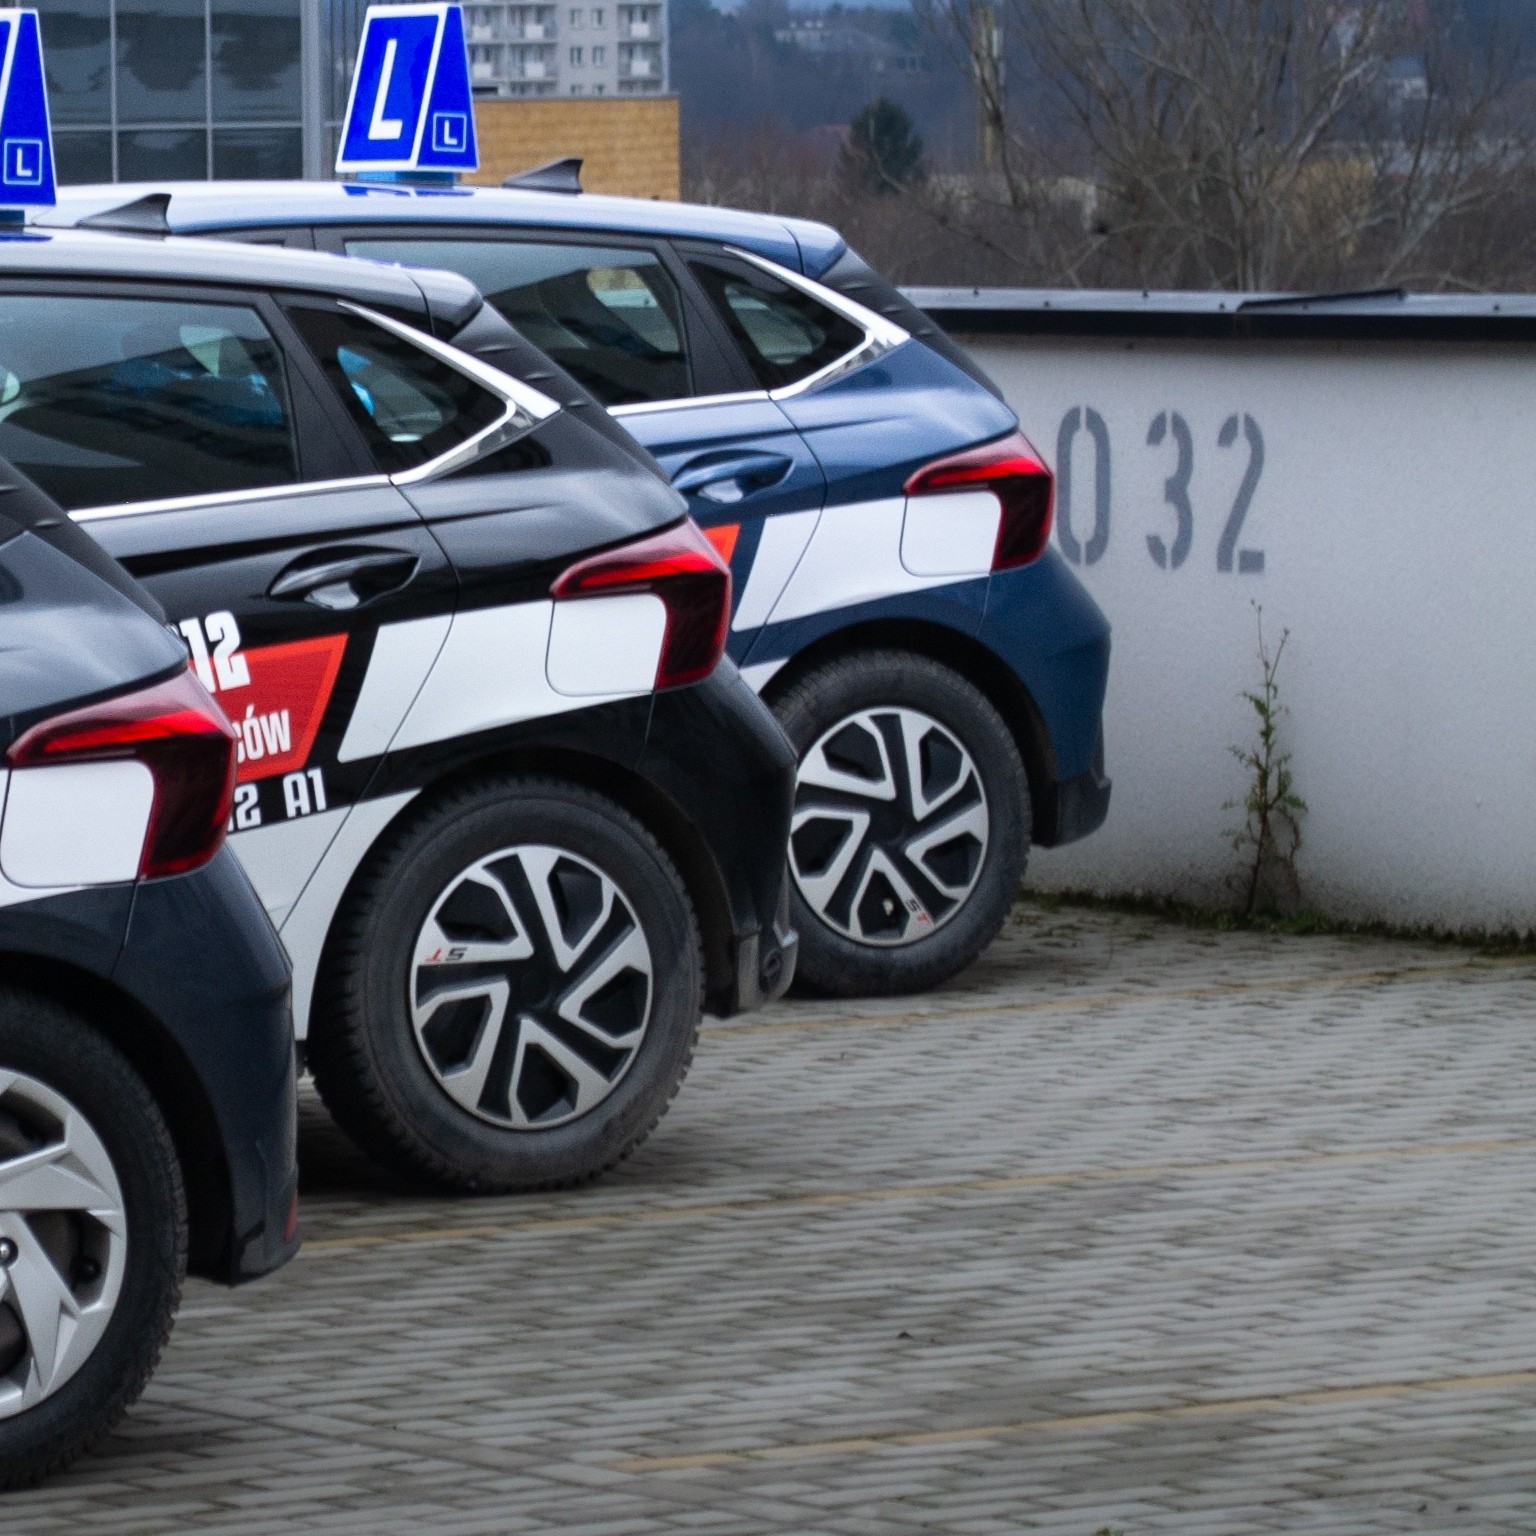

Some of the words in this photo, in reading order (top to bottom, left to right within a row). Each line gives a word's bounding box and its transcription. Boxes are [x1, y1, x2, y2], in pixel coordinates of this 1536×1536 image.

[368, 39, 403, 140] L
[16, 148, 33, 177] L
[443, 119, 458, 145] L
[1056, 405, 1265, 575] 032
[171, 610, 251, 693] 12
[227, 782, 262, 831] 2
[282, 767, 327, 818] A1
